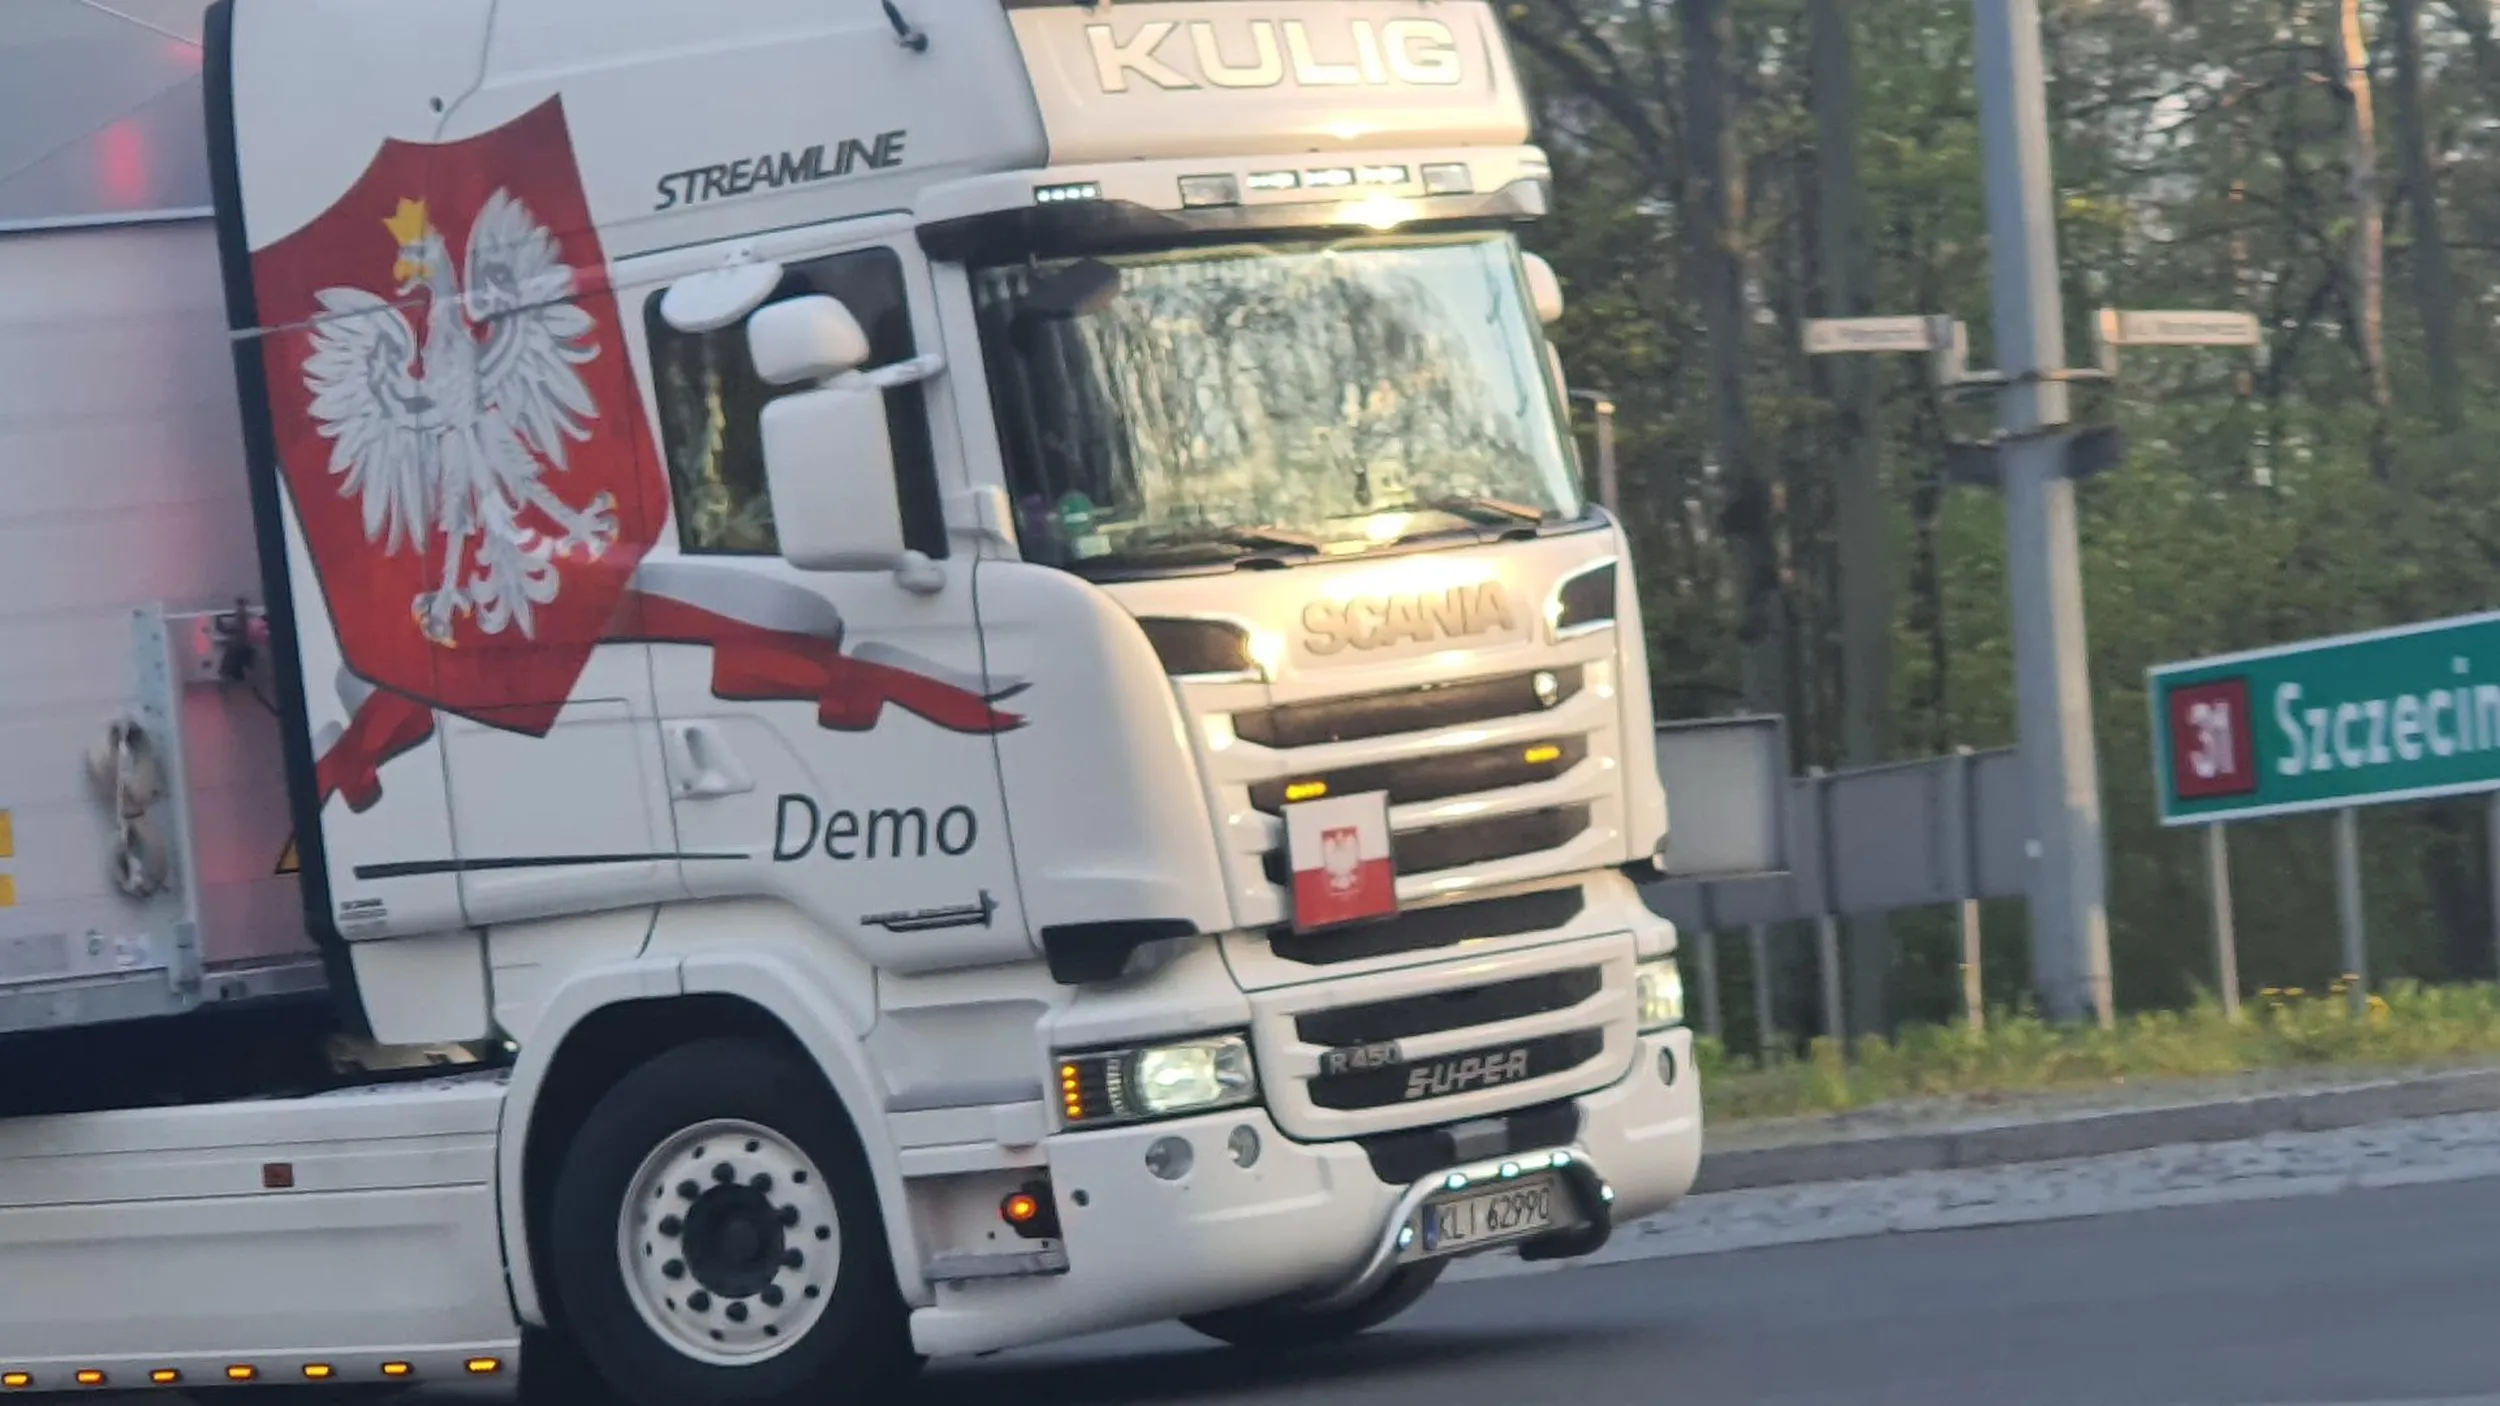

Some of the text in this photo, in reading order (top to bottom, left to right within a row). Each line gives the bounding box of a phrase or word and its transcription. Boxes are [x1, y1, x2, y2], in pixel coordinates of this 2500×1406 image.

[1084, 18, 1463, 94] KULIG
[654, 129, 906, 211] STREAMLINE
[1302, 580, 1517, 656] SCANIA
[2187, 655, 2500, 779] 31 Szczecin
[772, 792, 978, 862] Demo
[1405, 1048, 1529, 1100] SUPER
[1487, 1186, 1550, 1232] 62990
